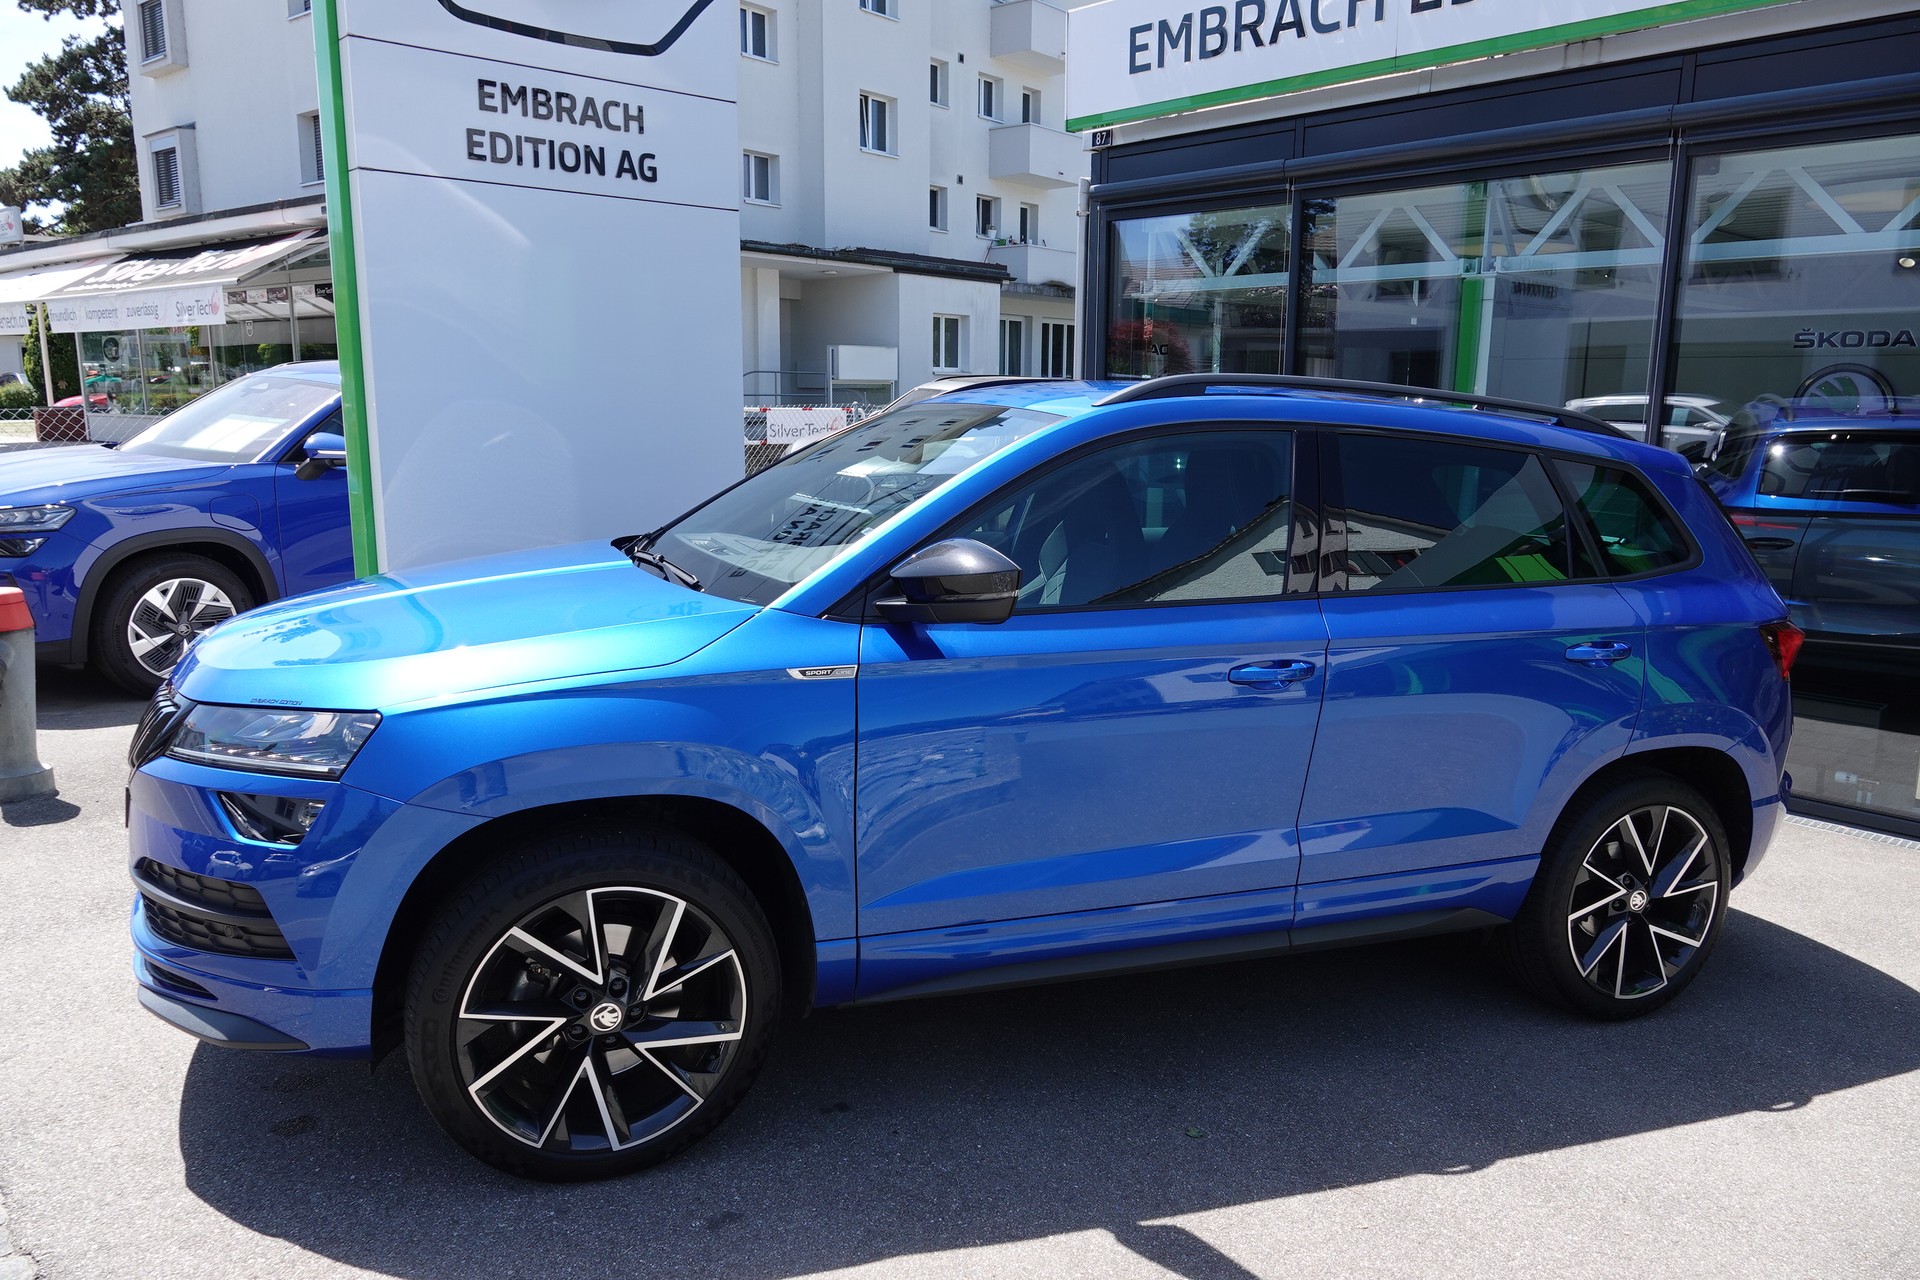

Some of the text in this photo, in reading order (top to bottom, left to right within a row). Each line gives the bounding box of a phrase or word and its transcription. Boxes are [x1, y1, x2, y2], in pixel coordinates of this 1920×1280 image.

[477, 78, 645, 135] EMBRACH
[1095, 131, 1107, 145] 87
[466, 127, 658, 183] EDITION AG
[85, 306, 118, 323] kompetent
[126, 302, 159, 320] zuverlässig
[175, 299, 213, 318] SilverTech
[1793, 328, 1918, 349] ŠKODA
